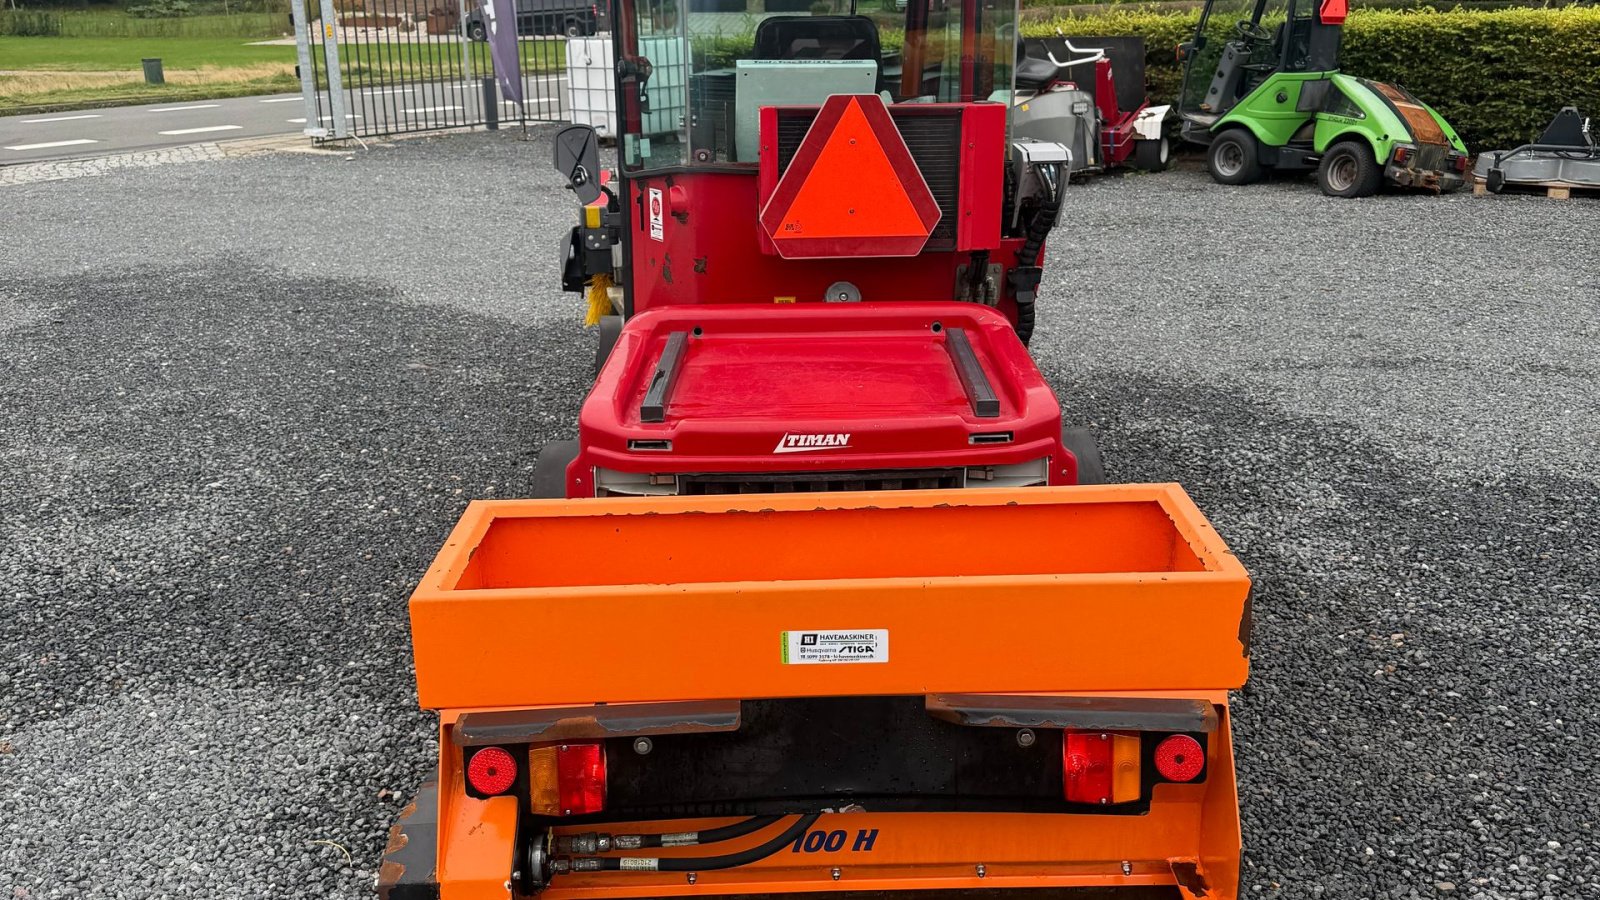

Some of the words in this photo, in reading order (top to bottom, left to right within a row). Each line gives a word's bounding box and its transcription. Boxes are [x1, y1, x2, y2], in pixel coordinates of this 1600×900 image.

[786, 433, 851, 447] TIMAN
[792, 829, 848, 853] 100
[852, 828, 880, 851] H
